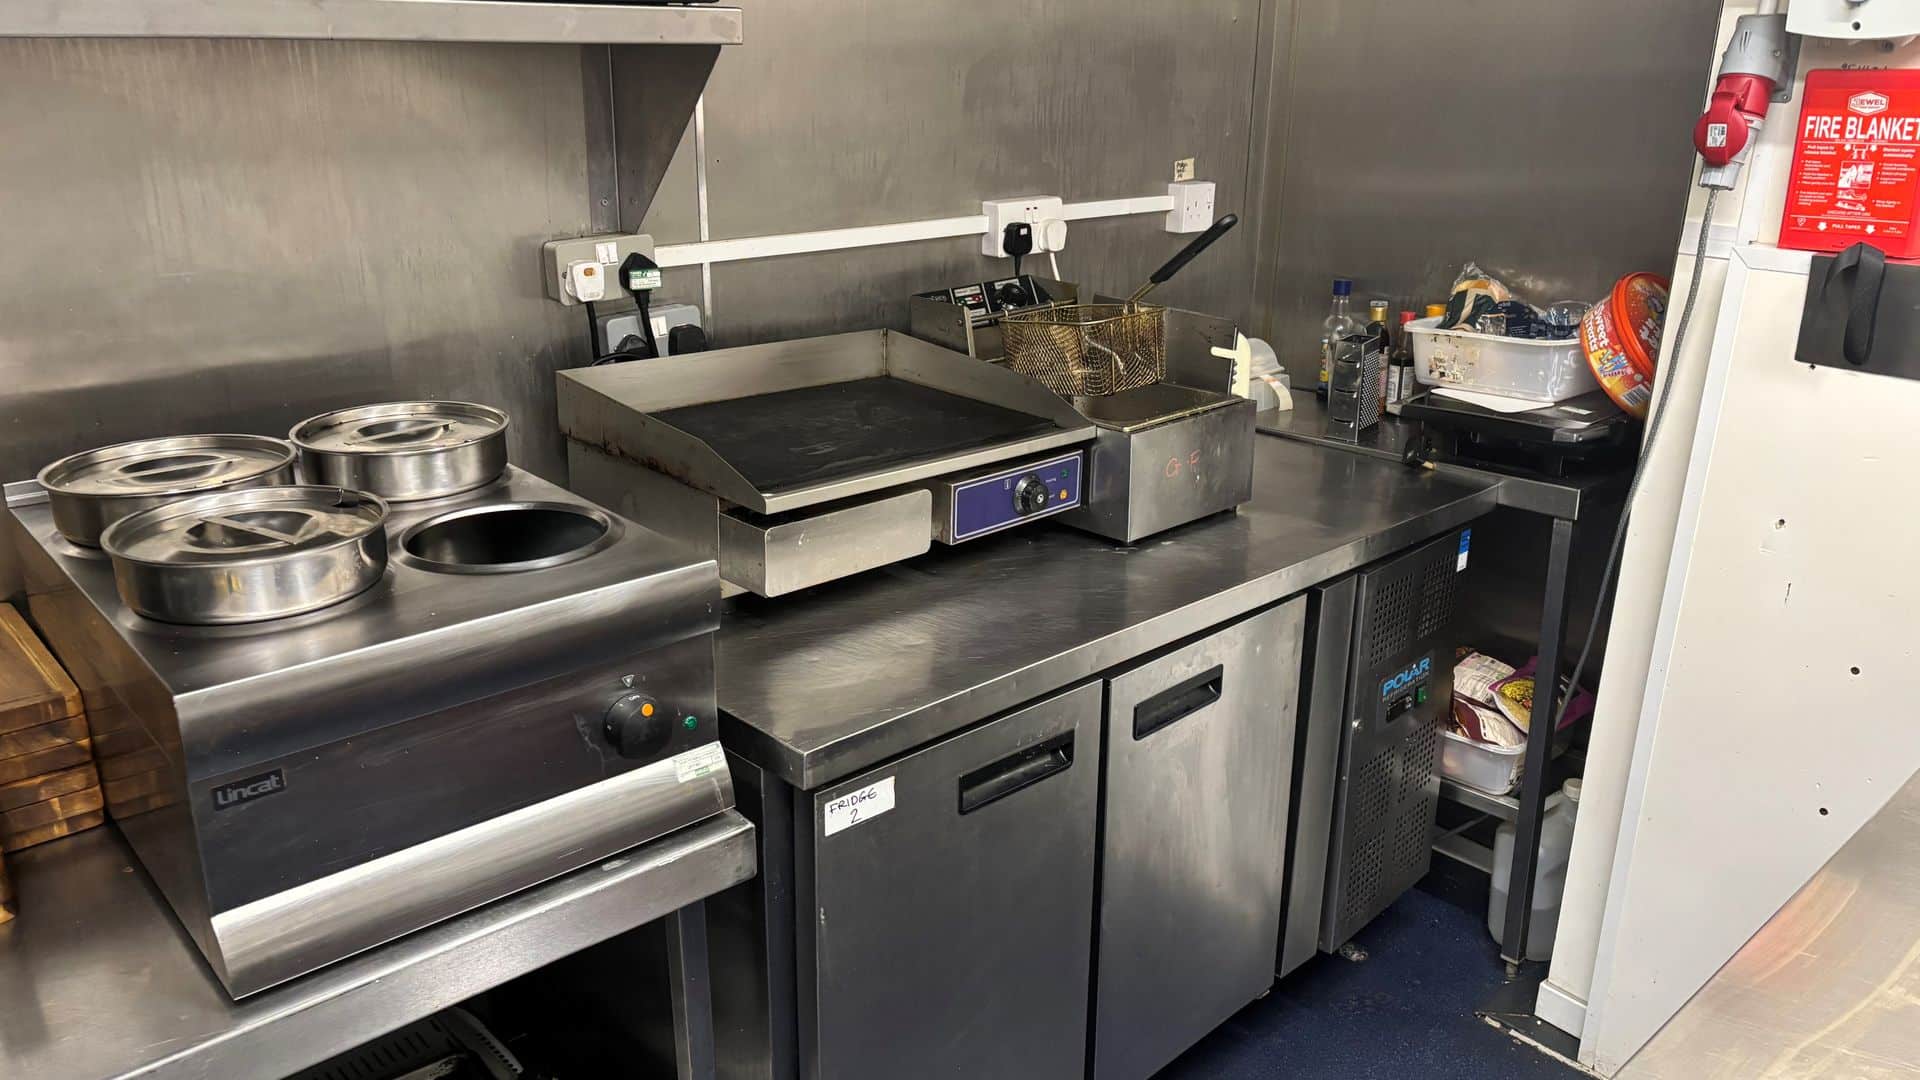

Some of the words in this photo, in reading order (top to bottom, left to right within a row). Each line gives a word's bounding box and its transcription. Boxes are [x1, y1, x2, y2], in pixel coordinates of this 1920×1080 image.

[1804, 116, 1842, 139] FIRE
[1585, 313, 1598, 352] Treats
[1594, 302, 1609, 347] Sweet
[1383, 658, 1430, 697] POLAR
[216, 775, 281, 805] Lincat
[830, 788, 878, 814] FRIDGE
[850, 808, 863, 824] 2
